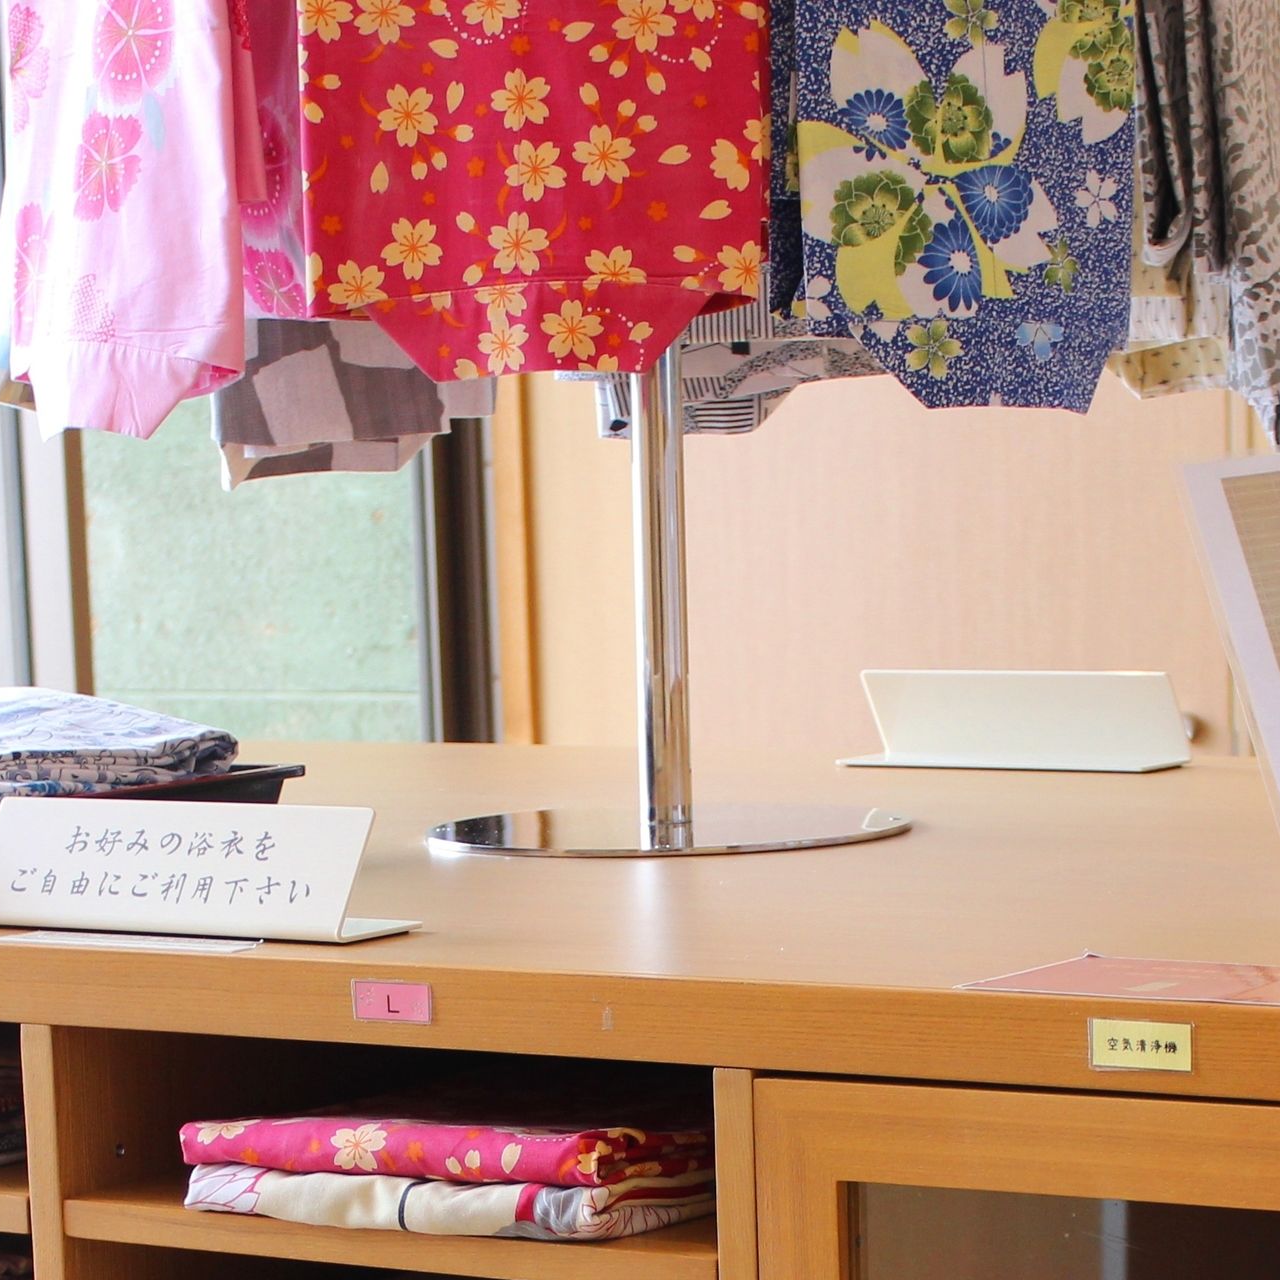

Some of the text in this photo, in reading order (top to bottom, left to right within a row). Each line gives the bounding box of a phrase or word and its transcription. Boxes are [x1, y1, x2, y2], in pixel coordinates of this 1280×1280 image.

[64, 824, 278, 862] お好みの浴衣を
[9, 867, 311, 905] ご自由にご利用下さい
[386, 994, 400, 1014] L
[1106, 1037, 1178, 1055] 空気清浄機
